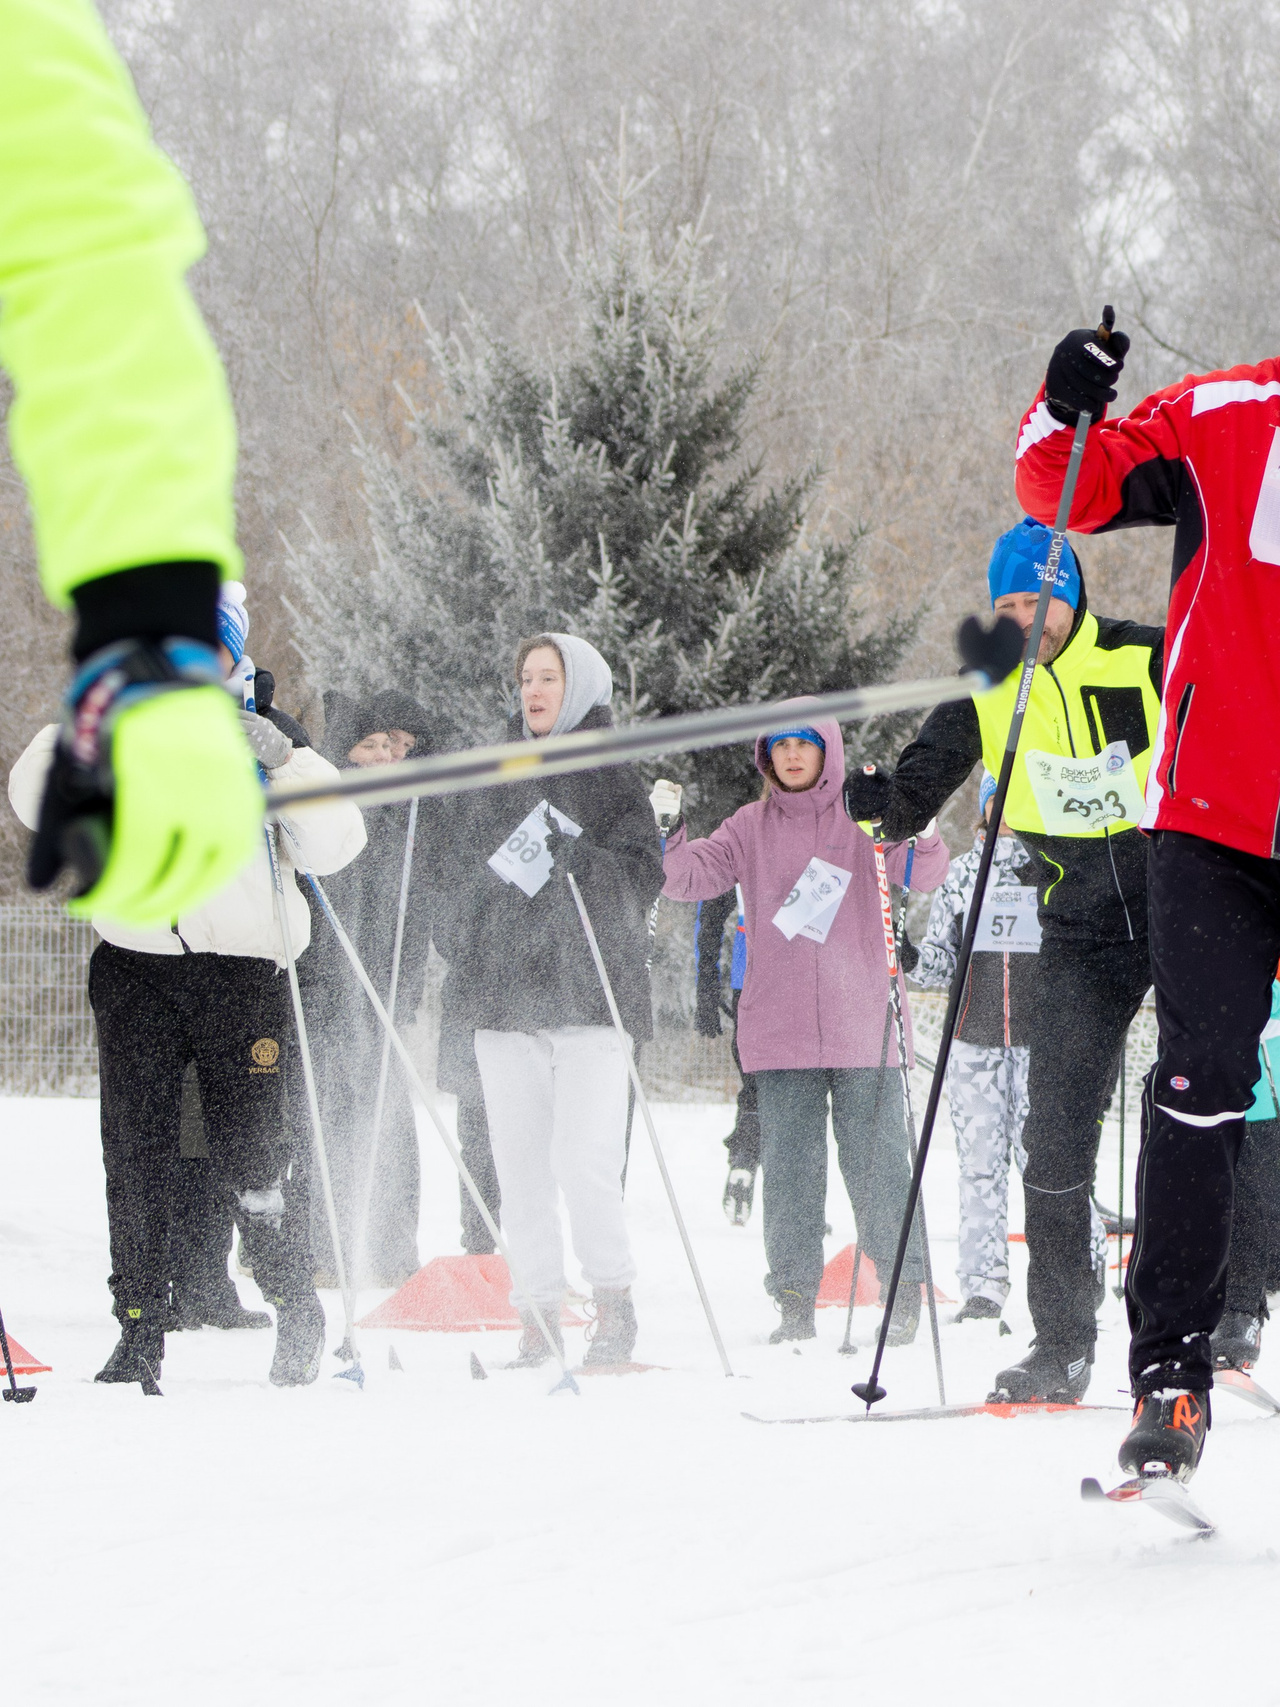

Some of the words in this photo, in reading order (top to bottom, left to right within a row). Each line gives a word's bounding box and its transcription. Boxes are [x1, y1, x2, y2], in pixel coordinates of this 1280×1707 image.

[1016, 667, 1034, 715] ROSSIGNOL
[1060, 773, 1102, 784] РОССИИ
[1061, 766, 1100, 776] ЛЫЖНЯ
[990, 915, 1018, 937] 57
